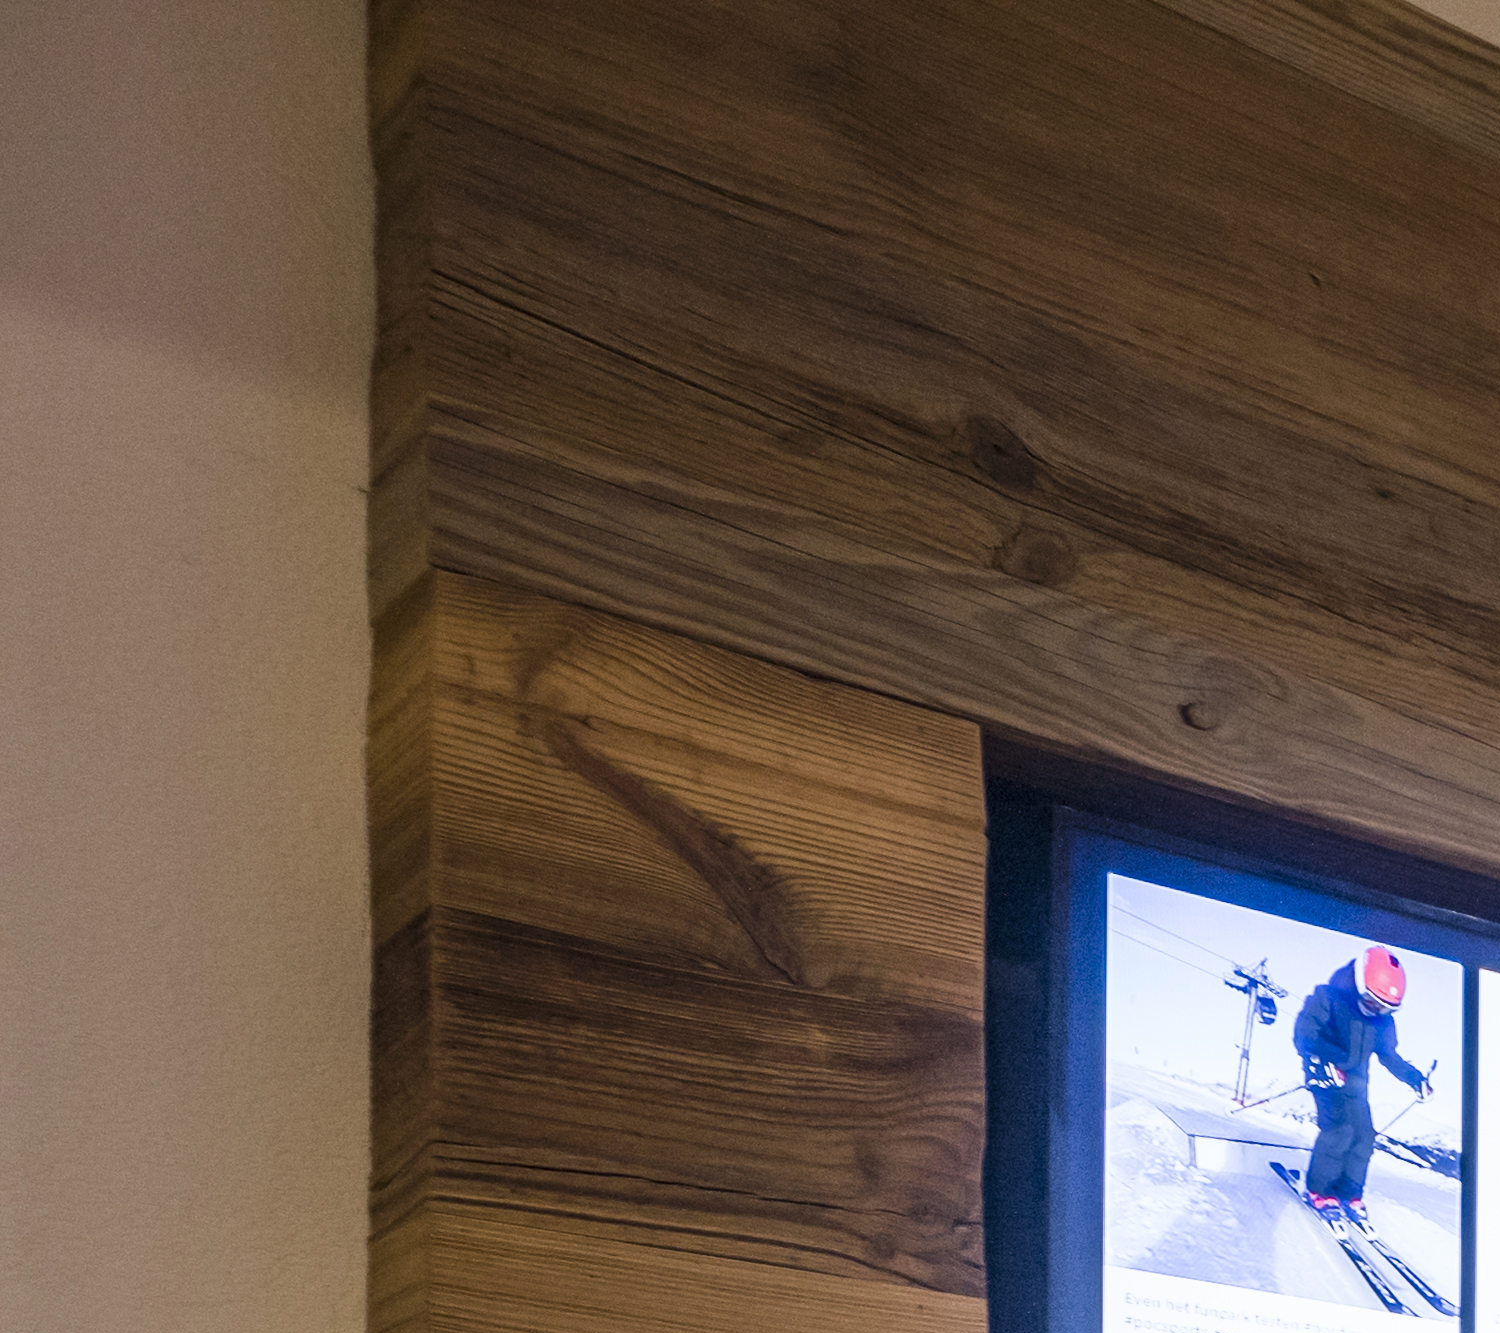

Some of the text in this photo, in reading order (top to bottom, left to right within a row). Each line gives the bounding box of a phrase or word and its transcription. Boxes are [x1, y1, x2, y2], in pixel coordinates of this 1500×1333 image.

[1125, 1292, 1160, 1309] Even
[1166, 1298, 1190, 1314] het
[1256, 1314, 1299, 1330] testen
